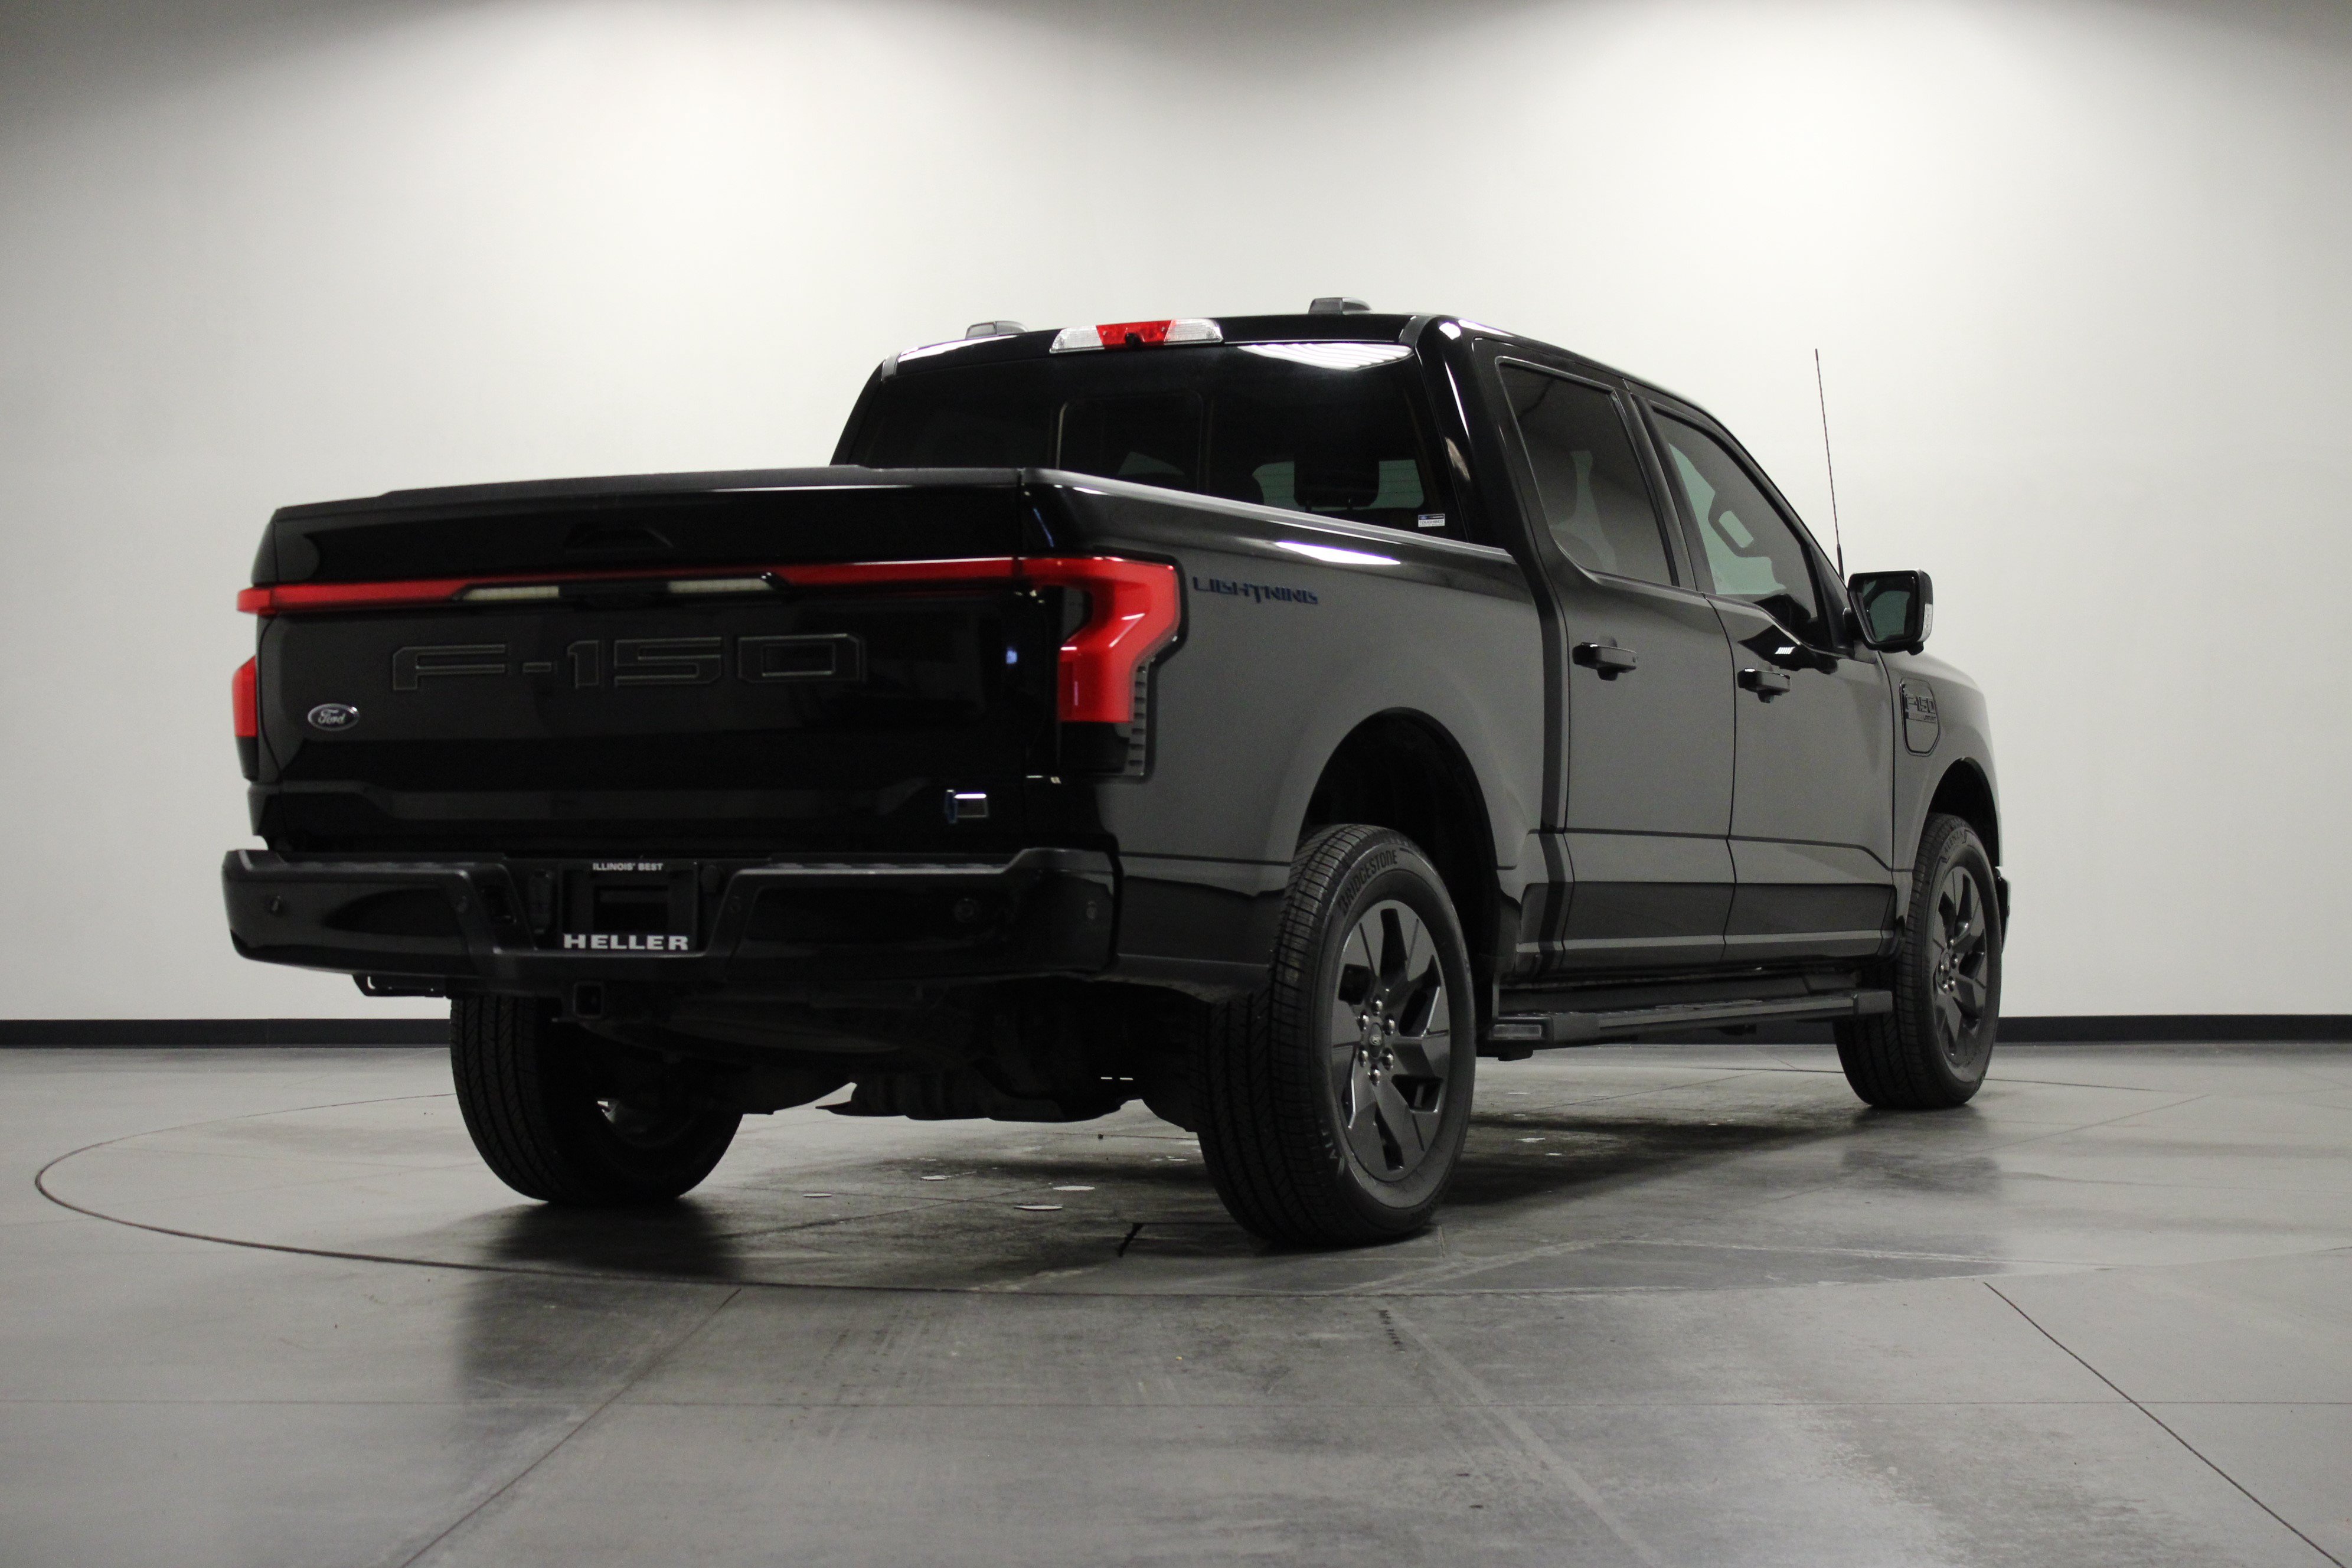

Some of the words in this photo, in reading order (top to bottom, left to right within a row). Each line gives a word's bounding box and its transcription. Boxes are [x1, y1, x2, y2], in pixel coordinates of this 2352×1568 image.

[1192, 576, 1318, 605] LIGHTNING
[393, 633, 864, 691] F-150
[318, 708, 346, 724] Ford
[638, 863, 663, 871] BEST
[1338, 850, 1397, 913] BRIDGESTONE
[563, 934, 688, 950] HELLER
